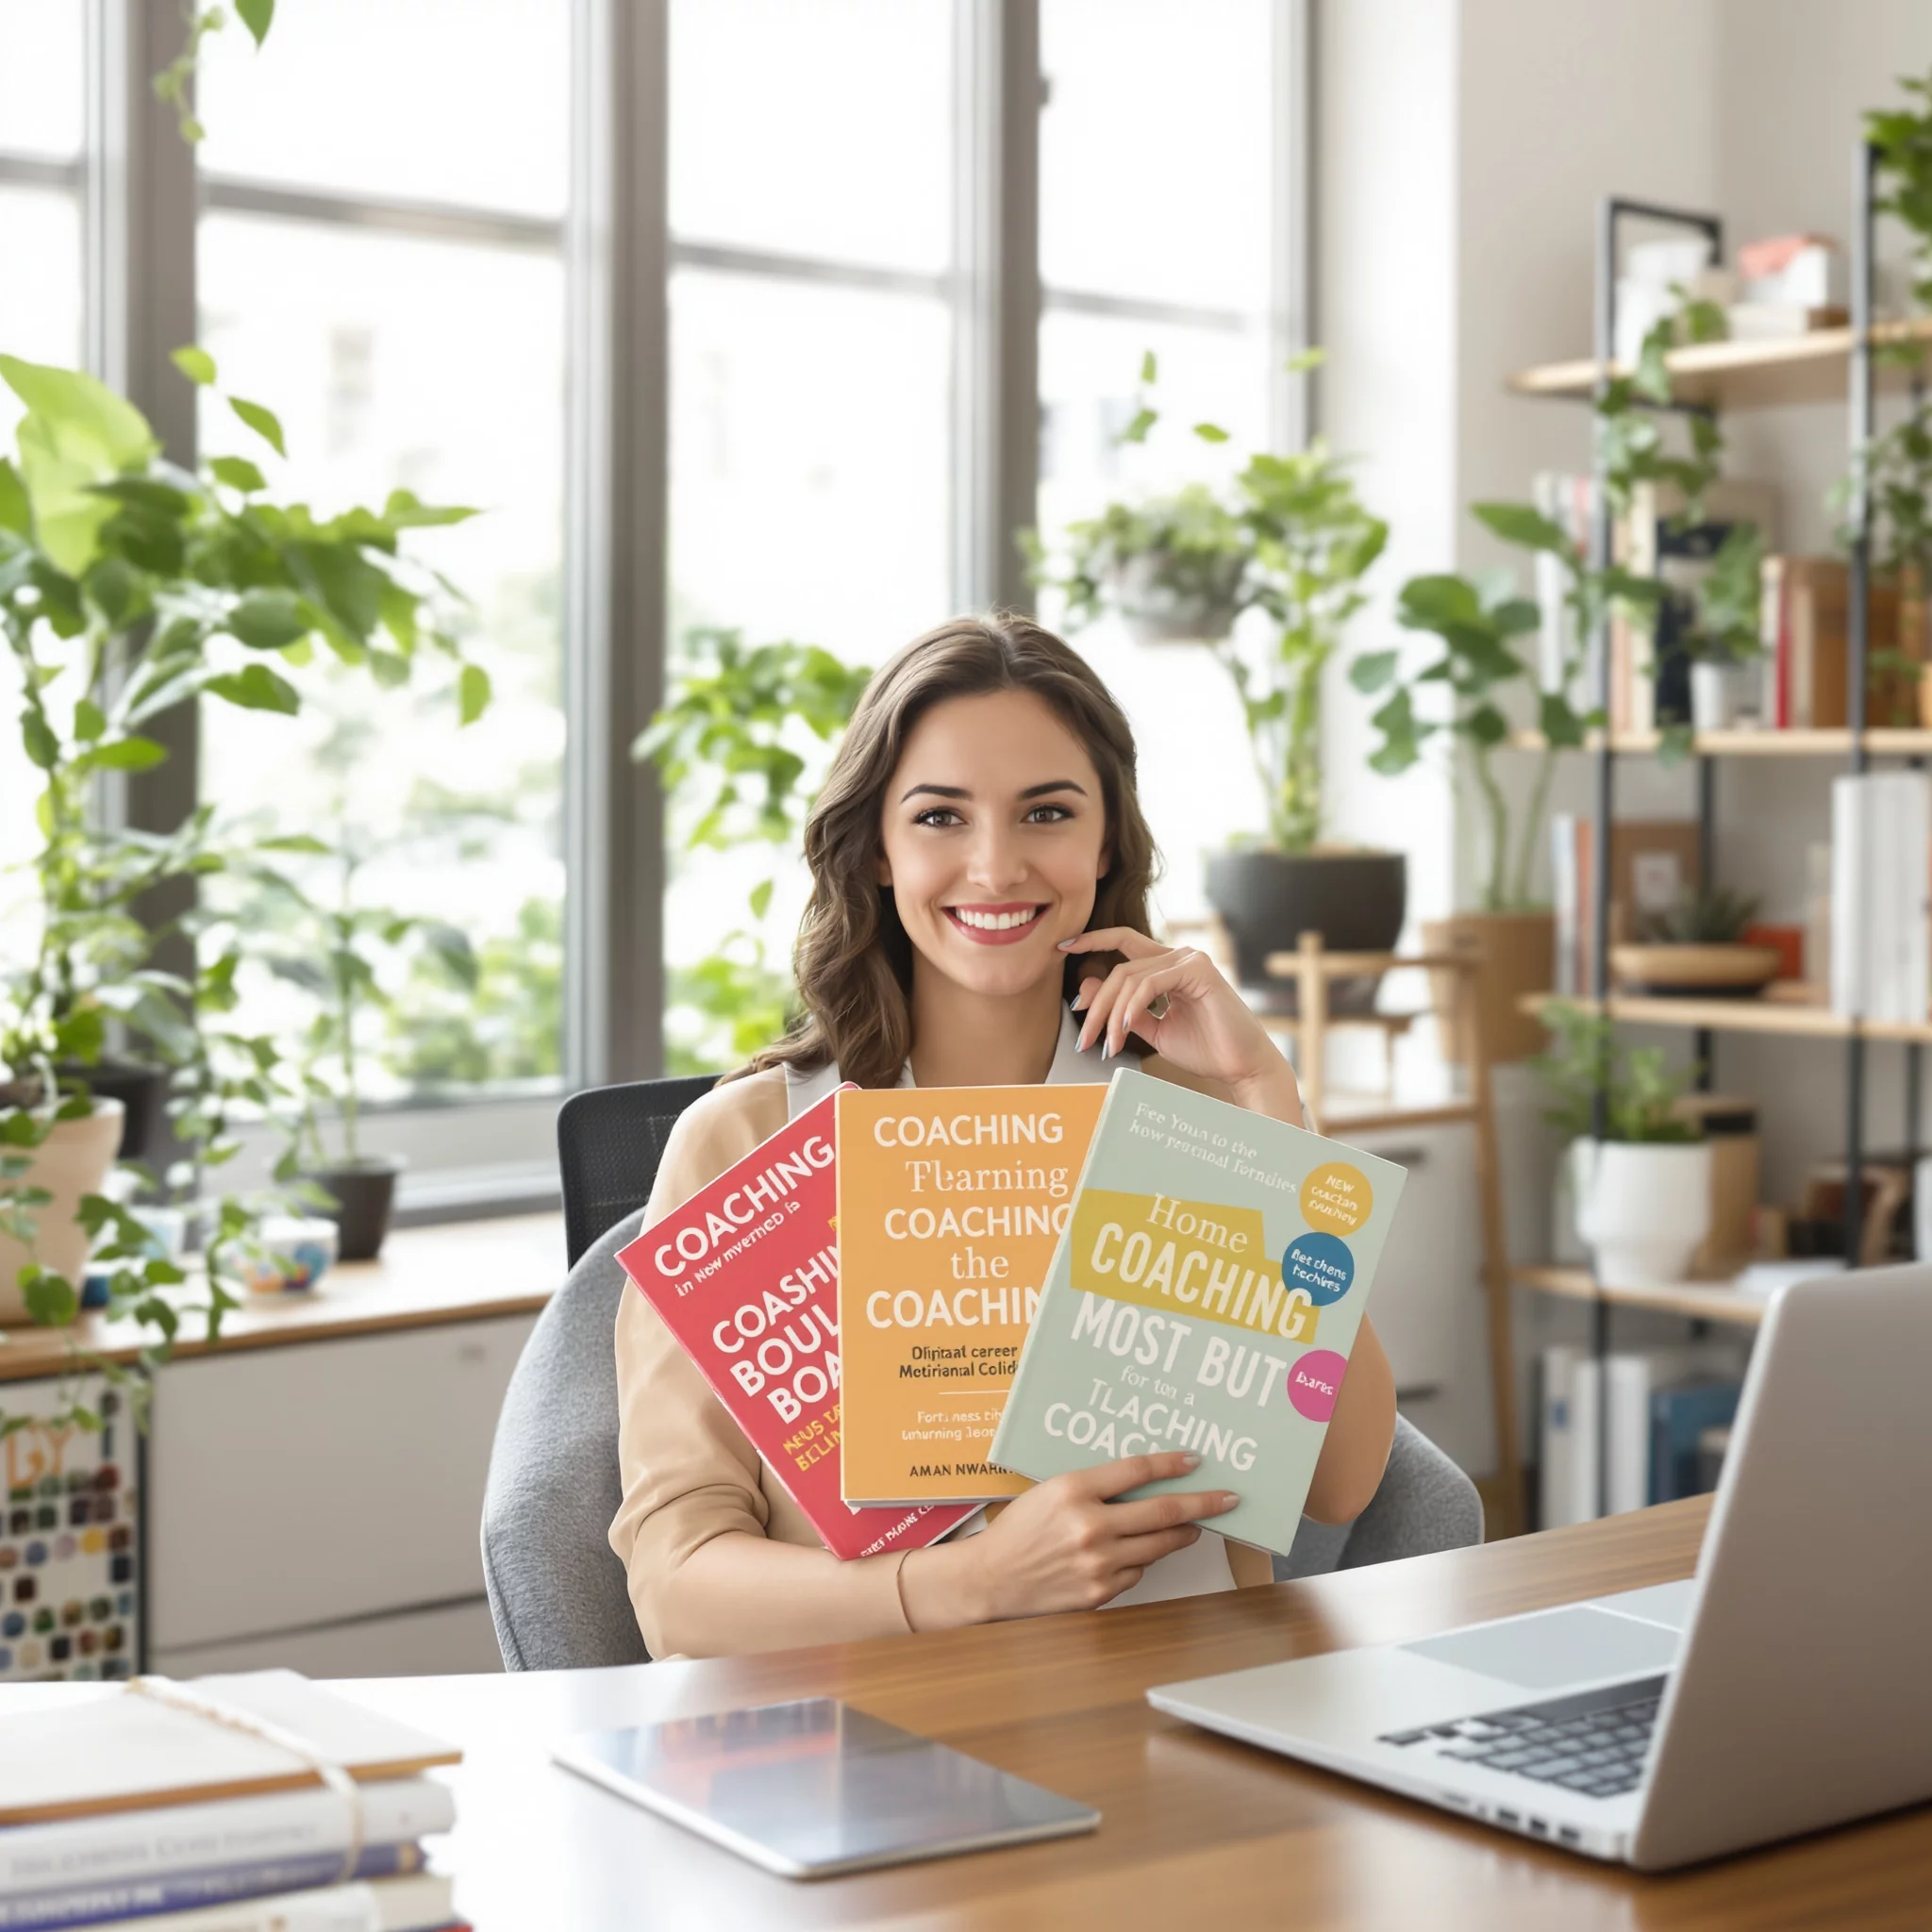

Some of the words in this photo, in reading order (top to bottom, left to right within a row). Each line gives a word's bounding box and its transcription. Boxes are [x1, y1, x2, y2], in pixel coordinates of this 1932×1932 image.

[874, 1113, 1063, 1147] COACHING
[1325, 1174, 1355, 1193] NEW
[655, 1136, 835, 1277] COACHING
[1146, 1191, 1248, 1253] Home
[950, 1246, 1009, 1279] the
[1091, 1223, 1312, 1340] COACHING
[971, 1346, 1018, 1358] career
[1070, 1291, 1192, 1373] MOST
[1196, 1336, 1288, 1407] BUT
[1184, 1391, 1195, 1407] a
[1043, 1402, 1167, 1460] COAC
[909, 1464, 951, 1476] AMAN
